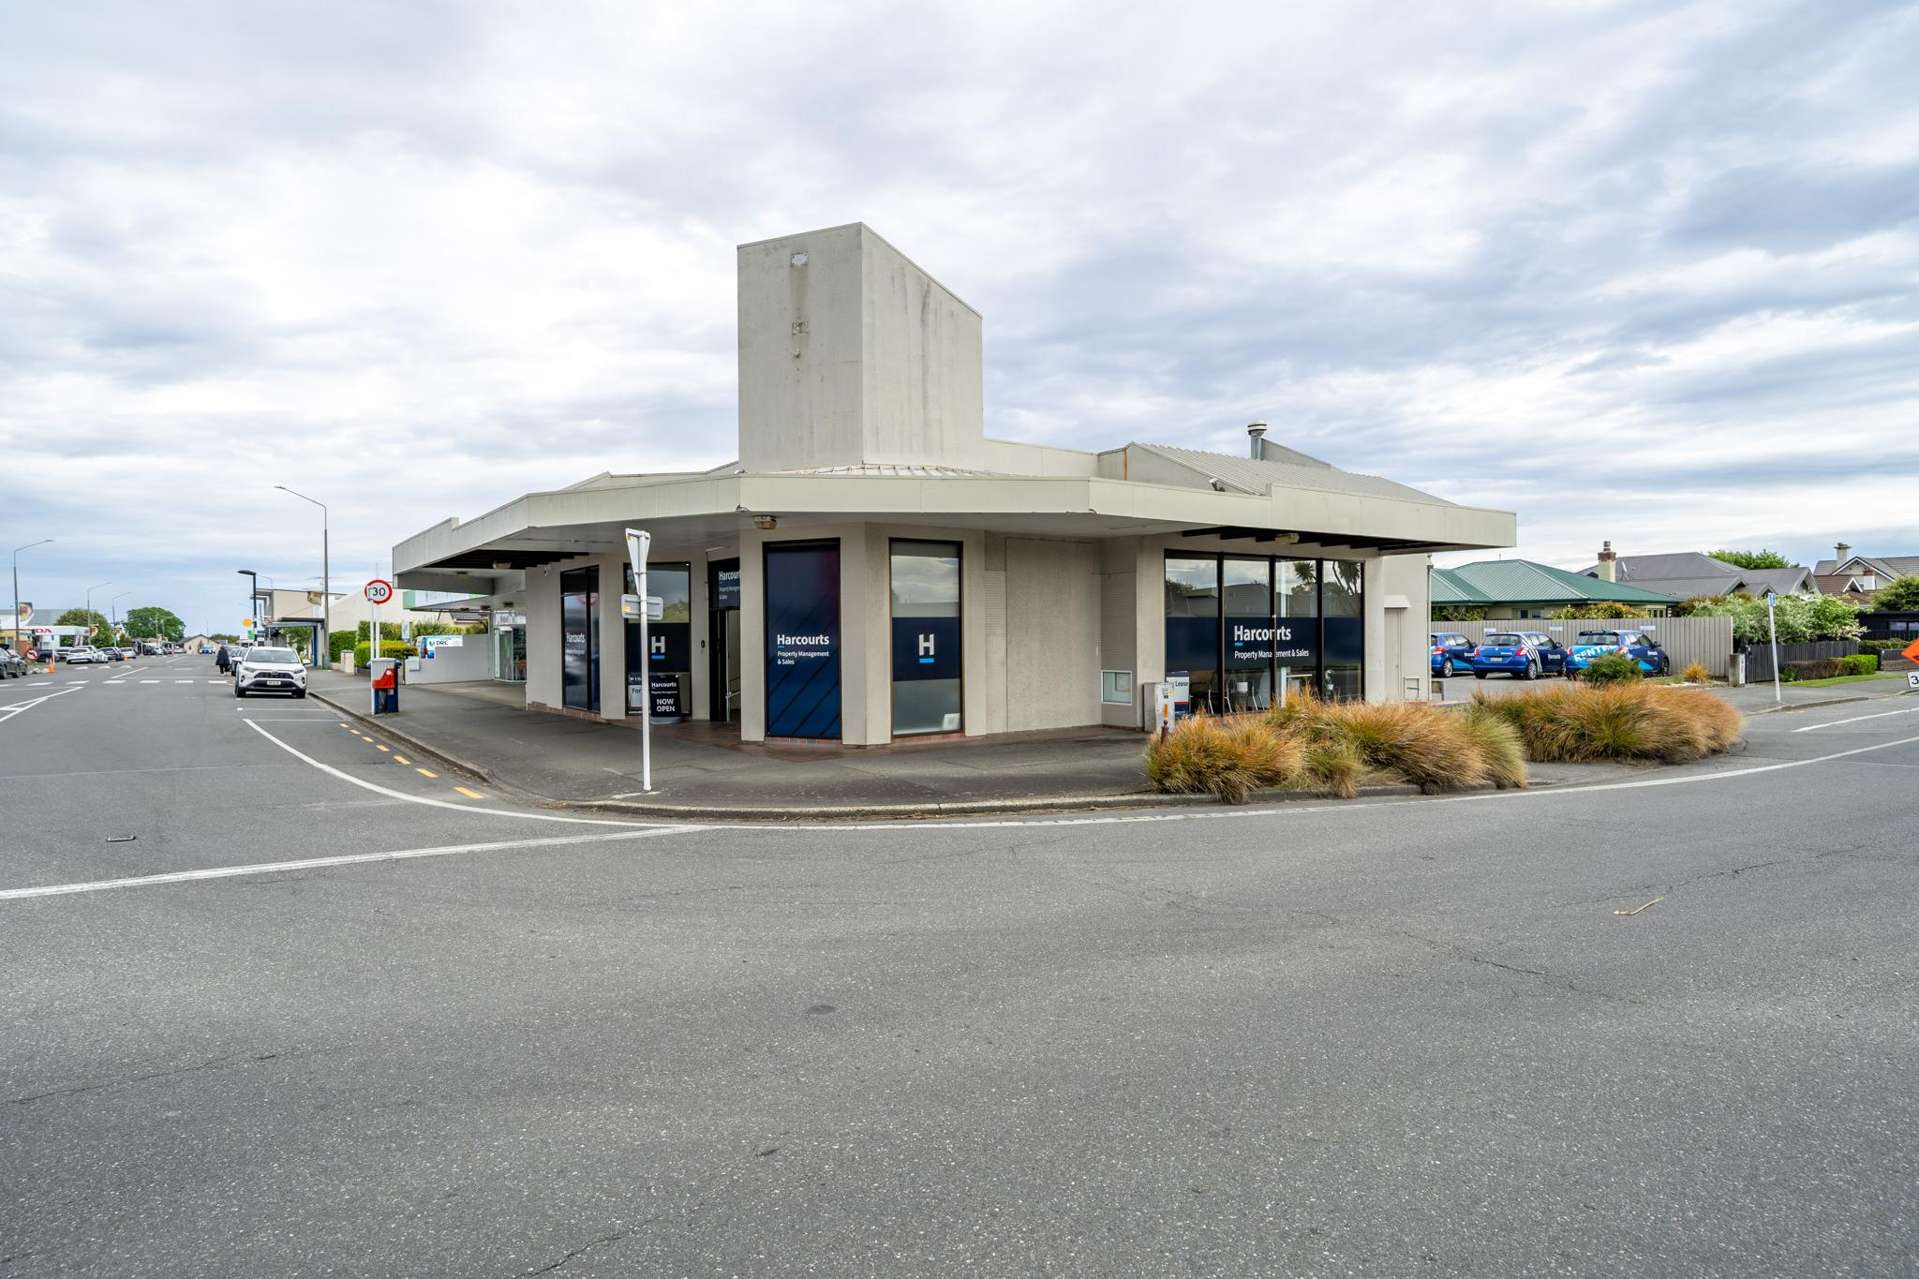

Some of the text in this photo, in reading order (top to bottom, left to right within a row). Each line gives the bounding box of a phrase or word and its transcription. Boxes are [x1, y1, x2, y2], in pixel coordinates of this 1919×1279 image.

[373, 586, 386, 597] 30
[651, 636, 666, 654] H
[777, 634, 830, 645] Harcourts
[919, 634, 935, 656] H
[777, 651, 798, 659] Property
[1234, 650, 1257, 660] Property
[1258, 650, 1290, 658] Manaement
[1296, 649, 1310, 657] Sales
